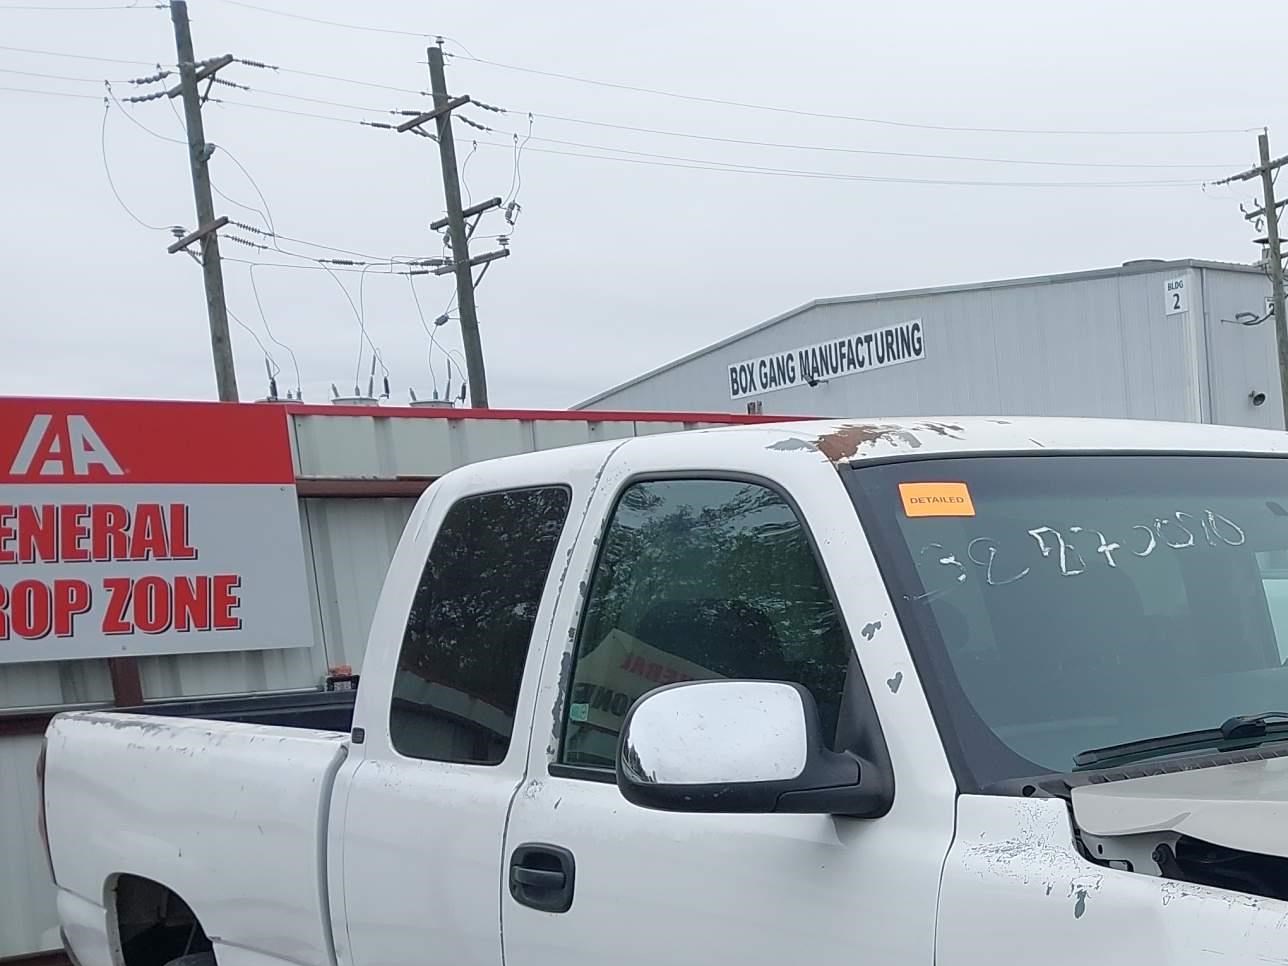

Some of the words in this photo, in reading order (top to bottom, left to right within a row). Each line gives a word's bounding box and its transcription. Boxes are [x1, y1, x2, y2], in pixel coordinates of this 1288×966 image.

[1167, 280, 1184, 291] BLDG
[1173, 293, 1181, 310] 2
[730, 362, 757, 396] BOX
[759, 352, 796, 390] GANG
[798, 322, 923, 382] MANUFACTURING
[910, 496, 964, 504] DETAILED
[0, 503, 198, 564] ENERAL
[0, 578, 92, 640] OP
[101, 574, 242, 635] ZONE
